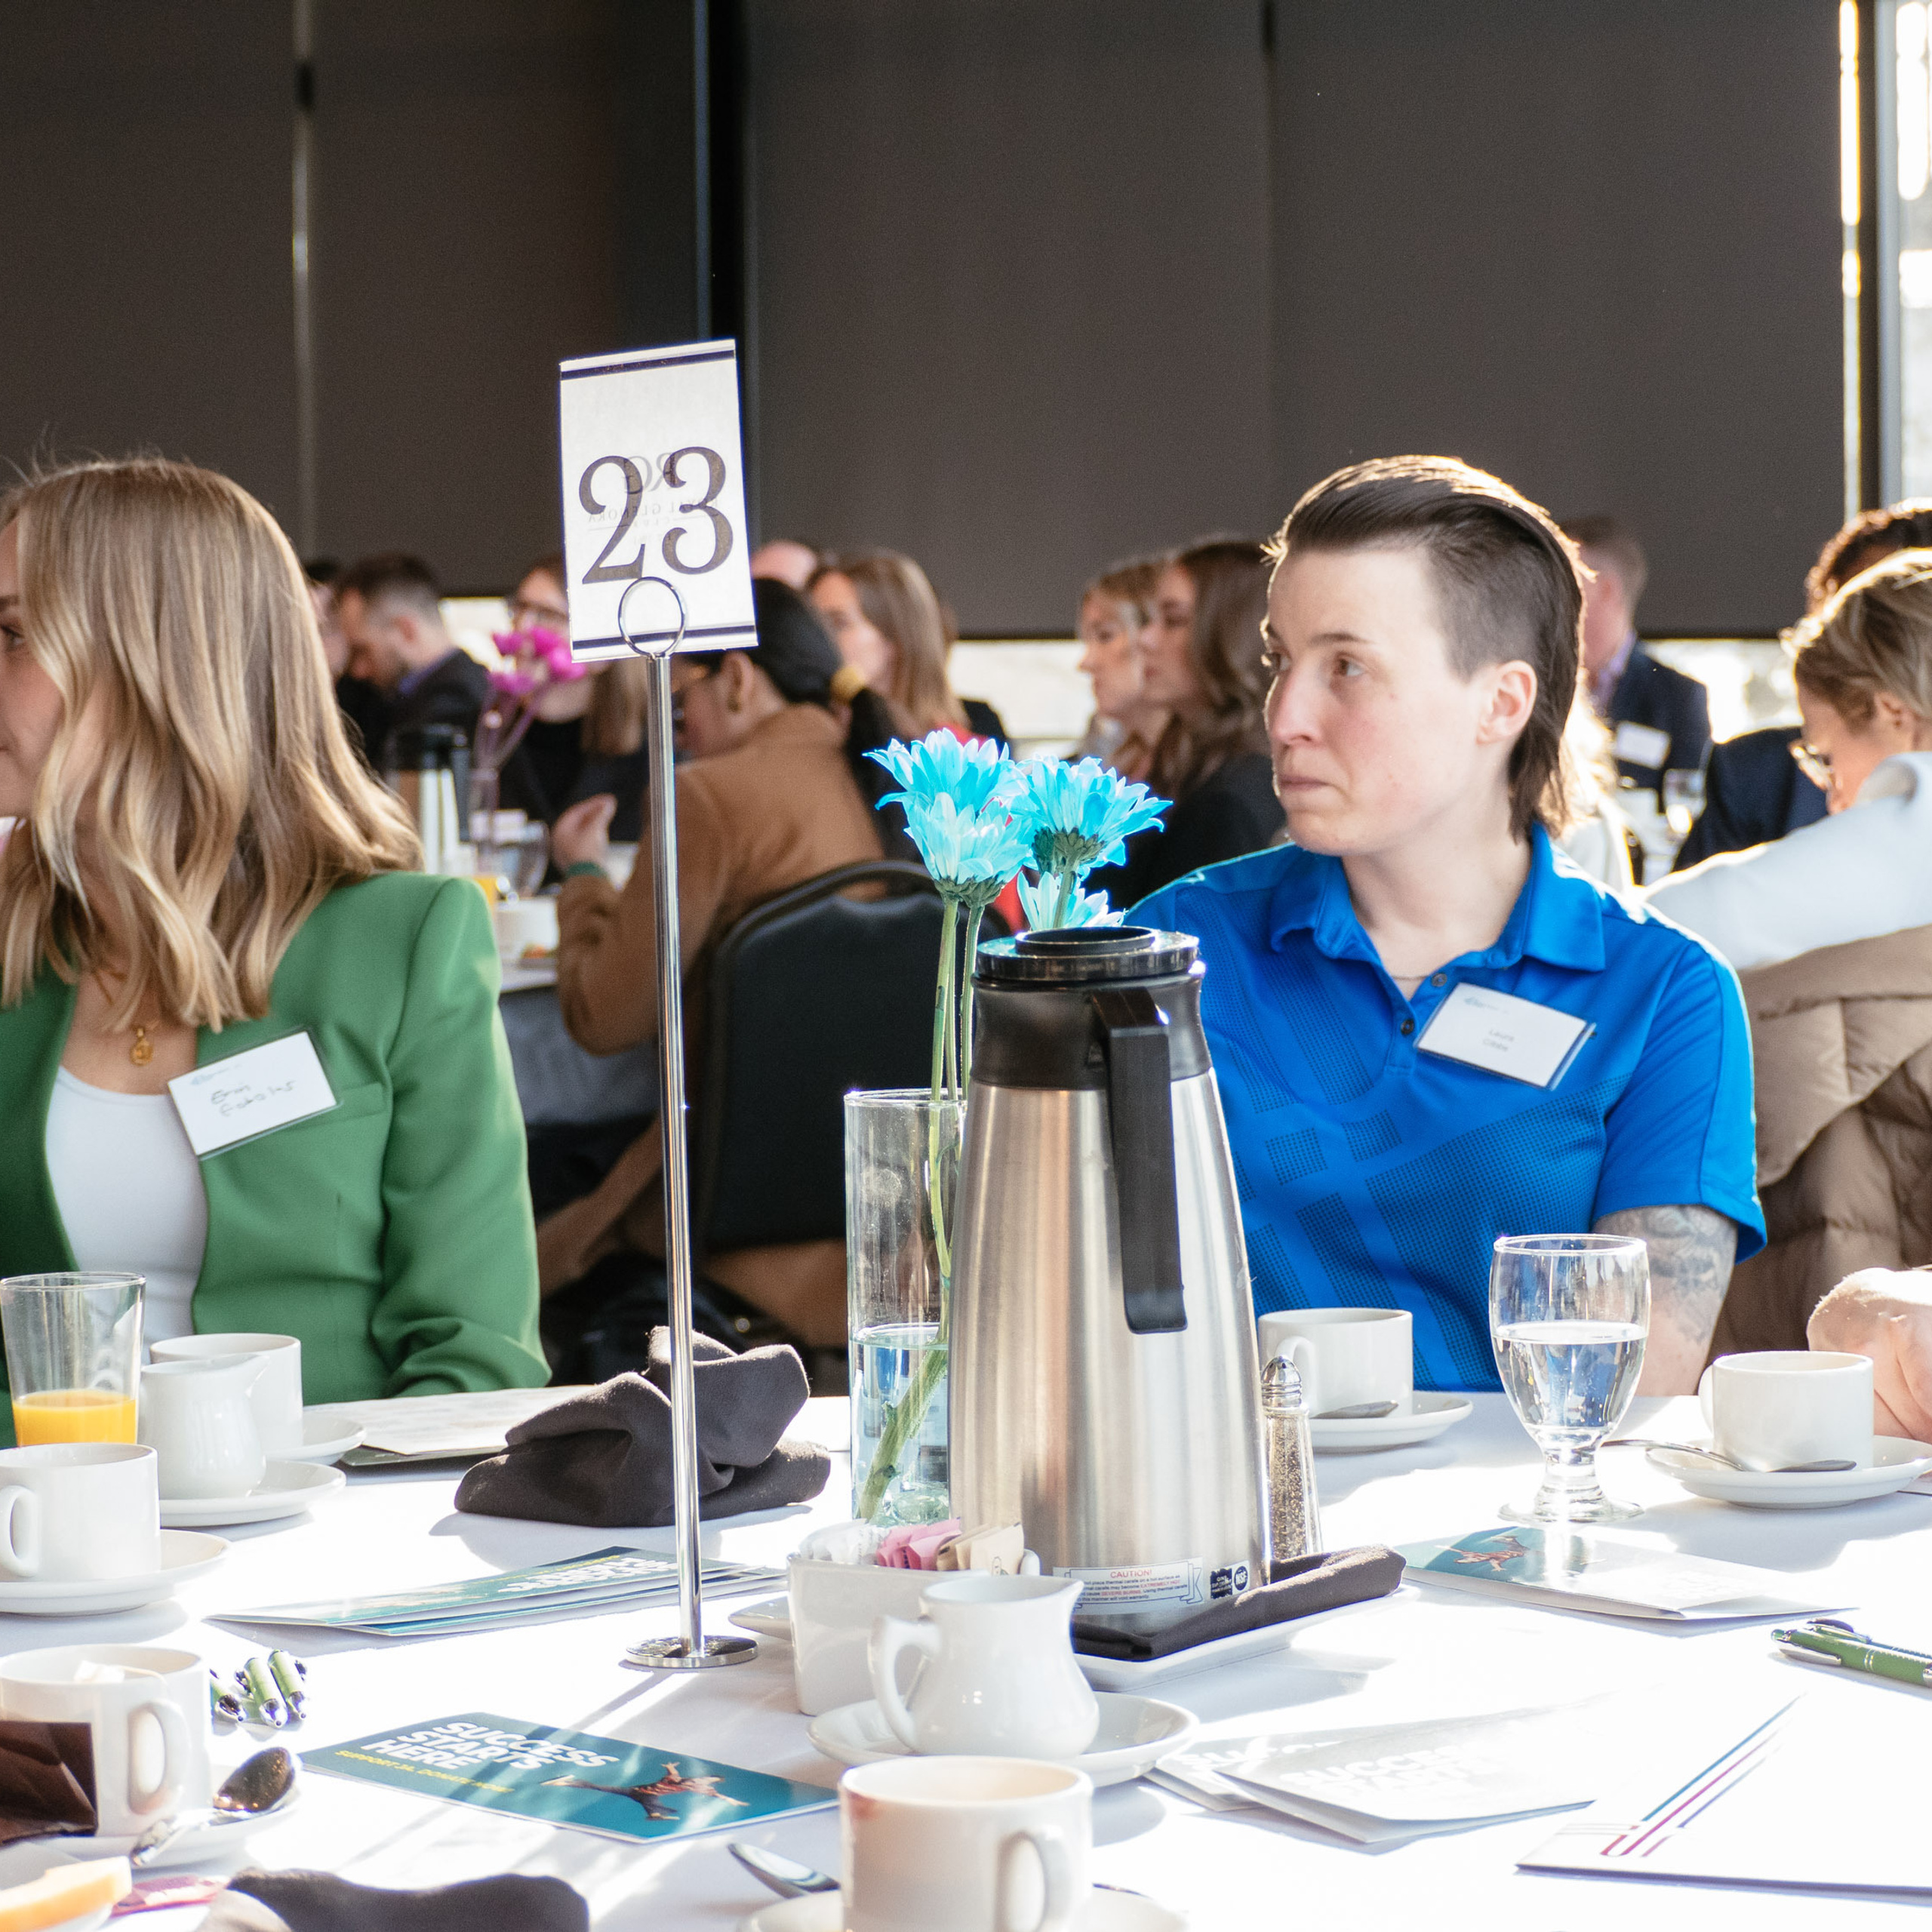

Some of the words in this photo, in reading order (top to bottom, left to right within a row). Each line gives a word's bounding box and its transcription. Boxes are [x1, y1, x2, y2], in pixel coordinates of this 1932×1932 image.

[579, 446, 734, 584] 23
[1110, 1569, 1152, 1578] CAUTION!
[361, 1739, 483, 1770] HERE
[397, 1730, 555, 1769] STARTS
[433, 1721, 620, 1768] SUCCESS
[334, 1749, 400, 1767] SUPPORT
[417, 1768, 475, 1785] DONATE
